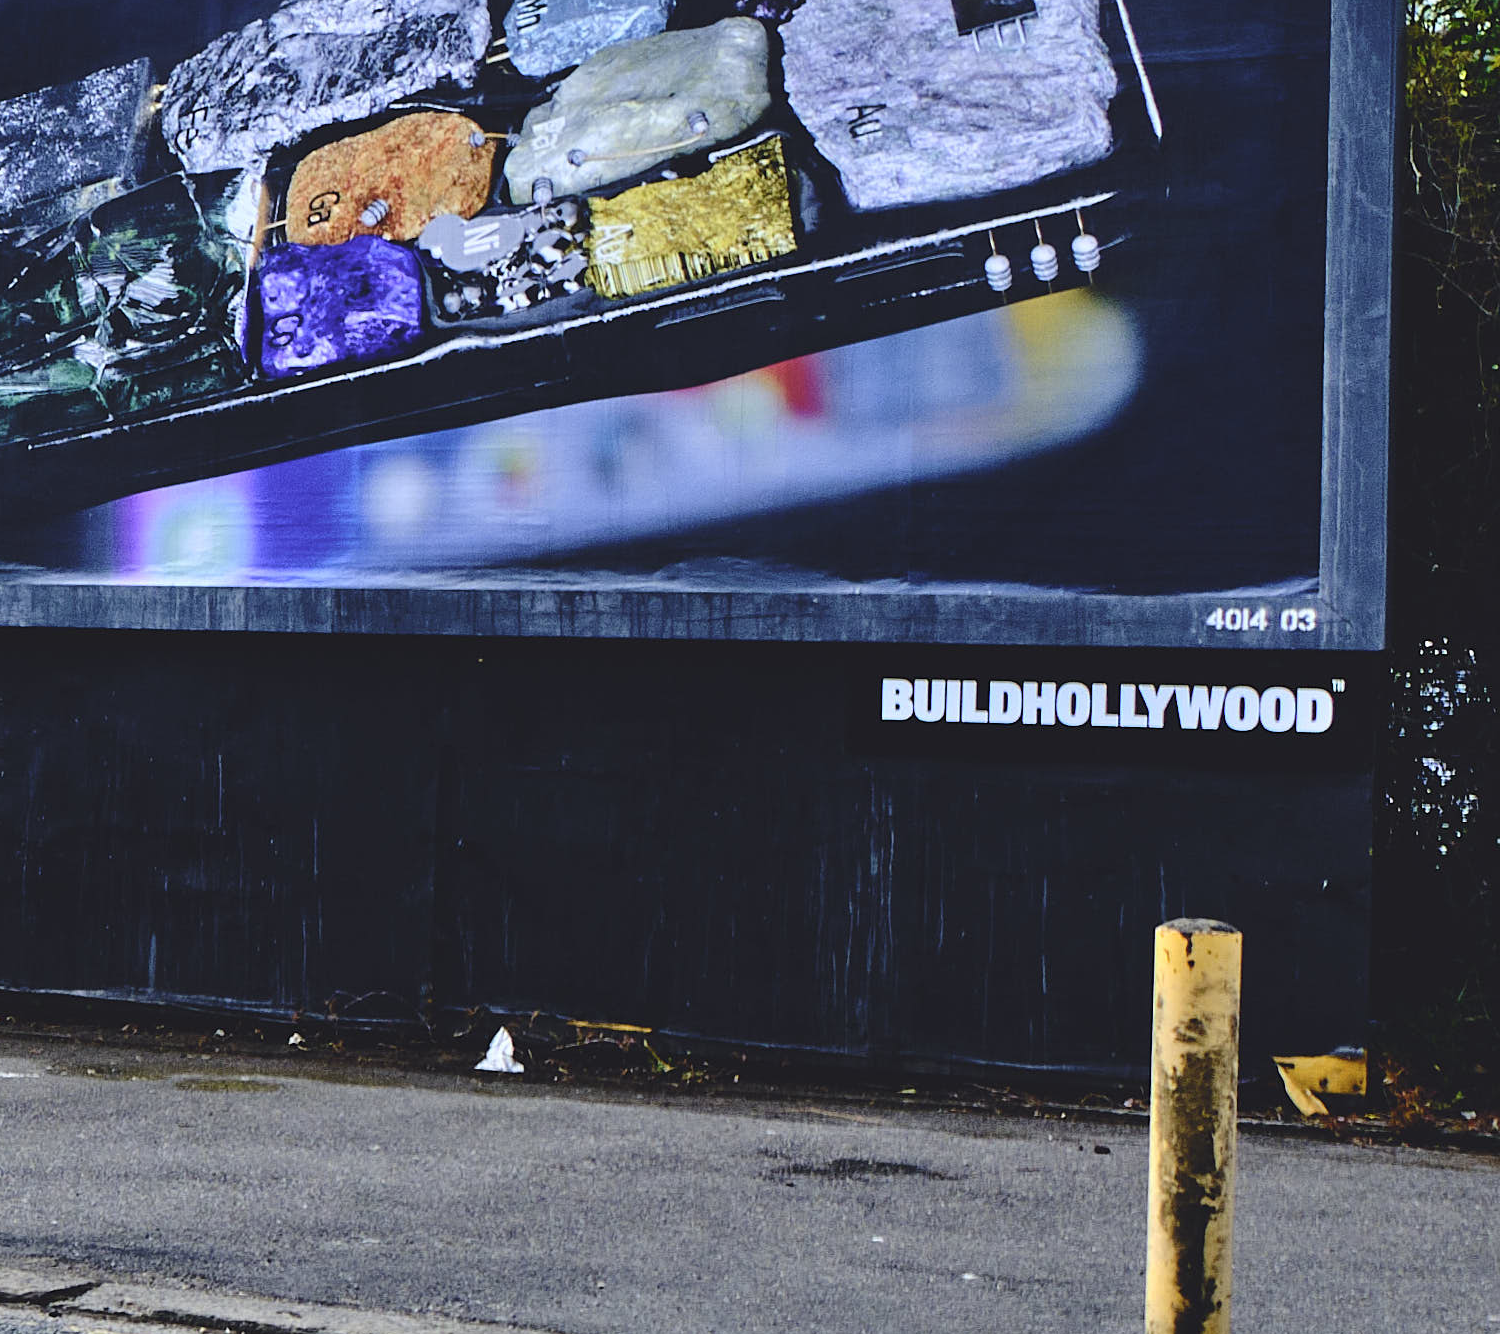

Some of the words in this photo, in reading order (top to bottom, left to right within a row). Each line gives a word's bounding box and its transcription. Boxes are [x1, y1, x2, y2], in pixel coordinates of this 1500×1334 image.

[846, 103, 887, 138] Au
[307, 191, 341, 227] Ga
[463, 222, 500, 256] Ni
[1206, 607, 1268, 631] 4014
[1280, 608, 1316, 631] 03
